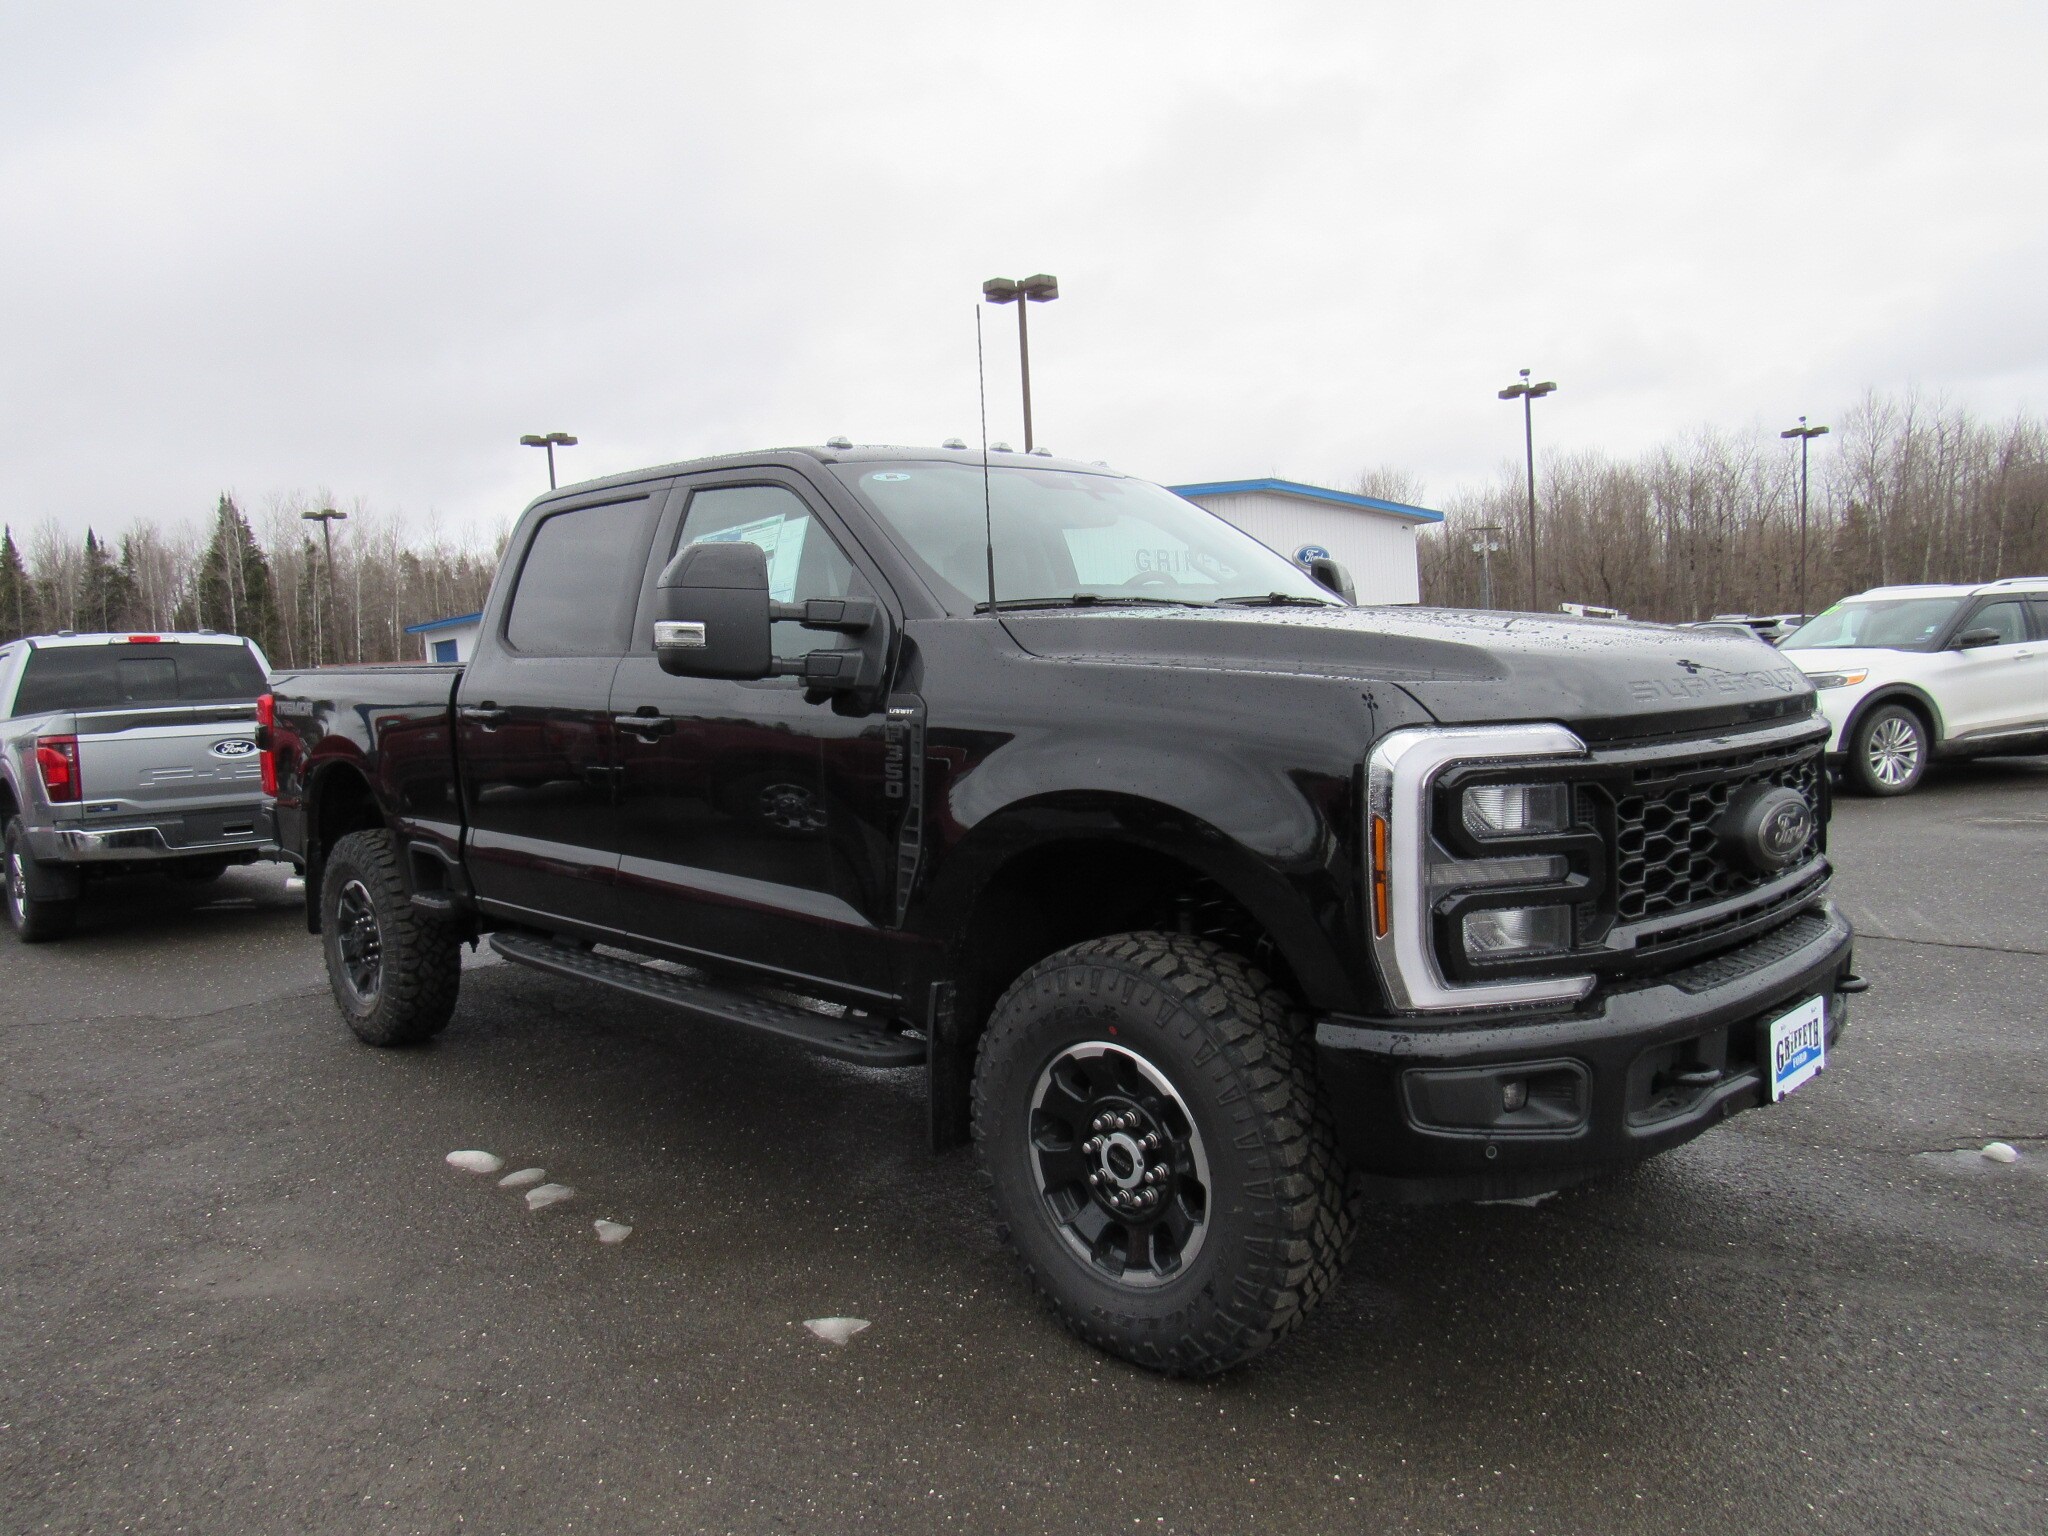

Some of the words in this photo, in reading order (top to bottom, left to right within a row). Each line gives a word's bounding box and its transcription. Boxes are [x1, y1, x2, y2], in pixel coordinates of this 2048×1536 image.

[221, 742, 249, 755] Ford
[1775, 807, 1805, 845] Ford
[1776, 1017, 1819, 1073] GRIFFETH
[1792, 1051, 1808, 1068] FORD
